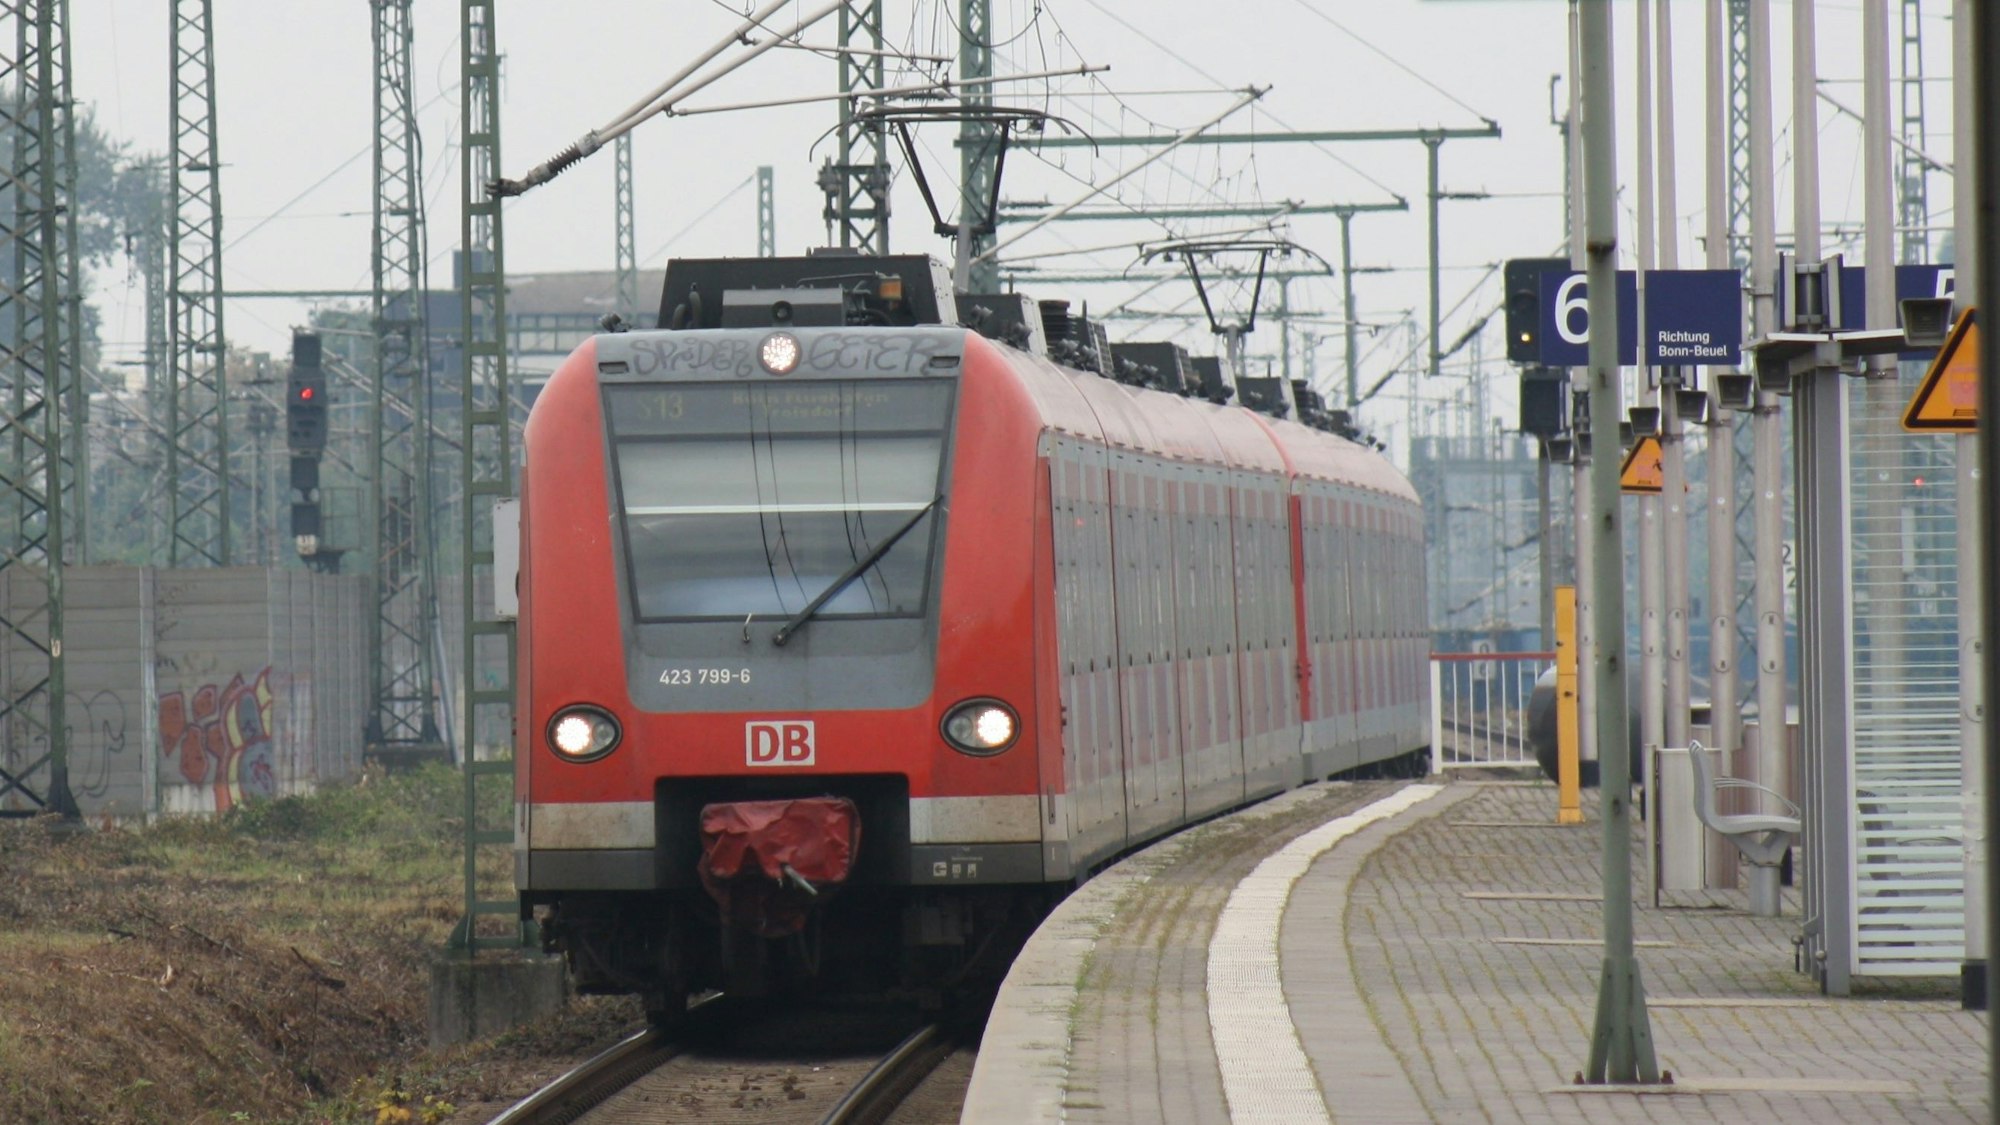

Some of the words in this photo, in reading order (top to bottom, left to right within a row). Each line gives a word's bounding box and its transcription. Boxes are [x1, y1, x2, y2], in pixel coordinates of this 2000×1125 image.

[1554, 273, 1590, 345] 6
[1658, 330, 1710, 344] Richtung
[1658, 344, 1728, 357] Bonn-Beuel
[659, 669, 692, 685] 423
[698, 668, 751, 685] 799-6
[750, 724, 811, 763] DB
